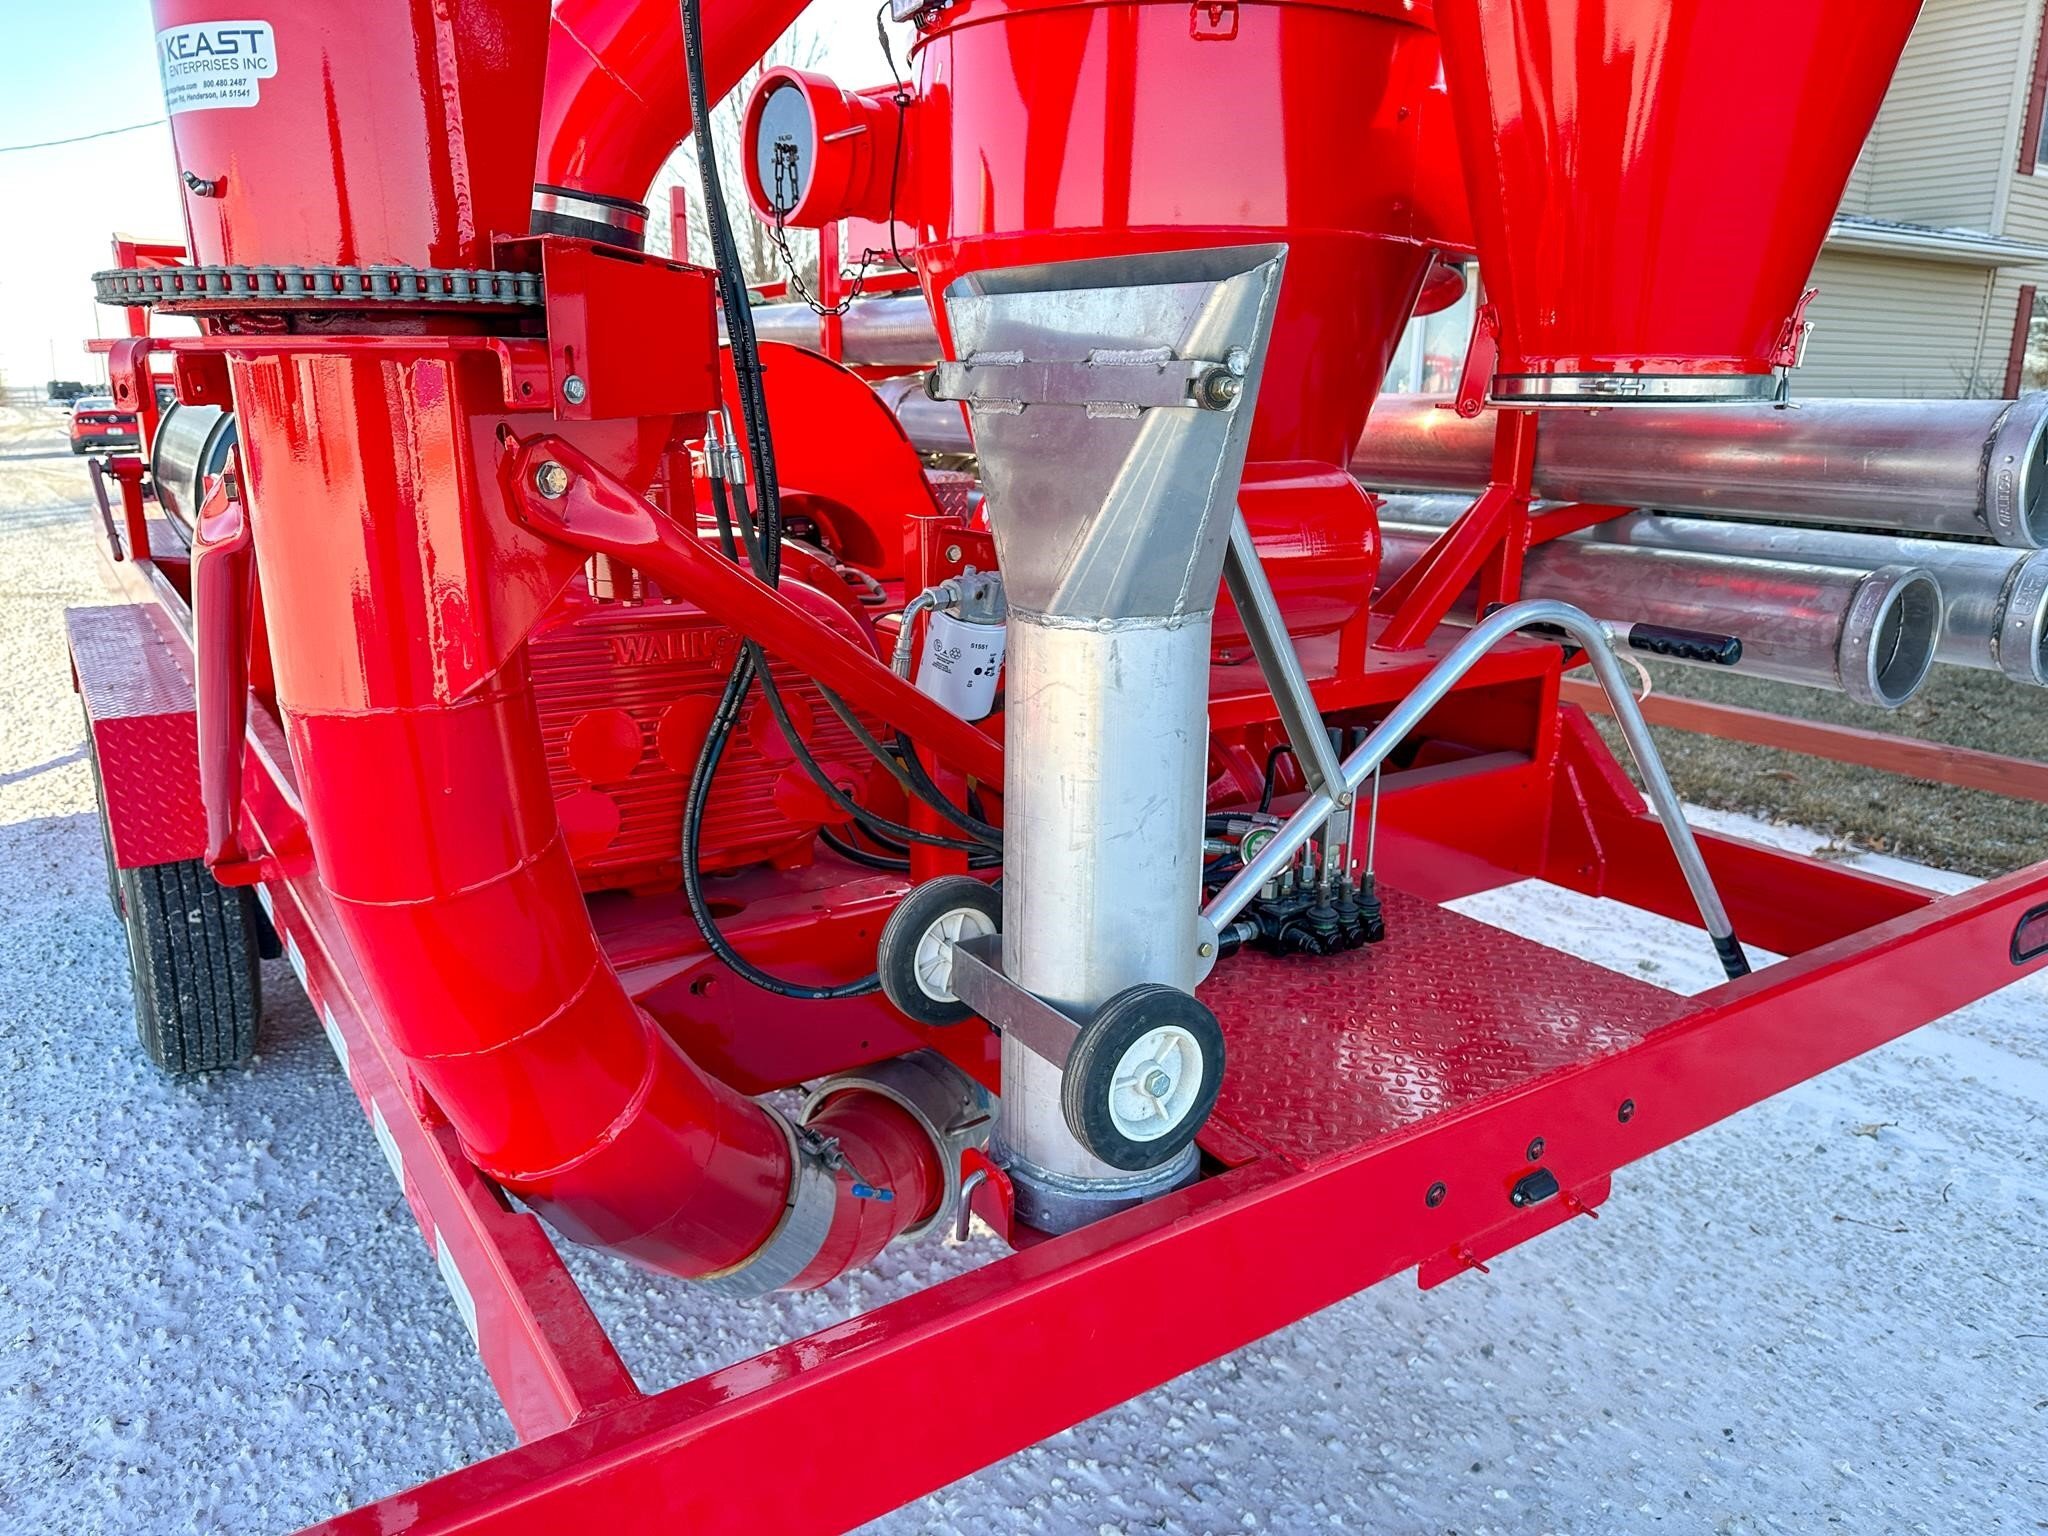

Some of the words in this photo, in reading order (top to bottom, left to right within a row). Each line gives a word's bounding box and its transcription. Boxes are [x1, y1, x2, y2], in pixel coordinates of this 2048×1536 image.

[165, 29, 264, 62] KEAST
[169, 58, 239, 77] ENTERPRISES
[243, 57, 268, 70] INC
[203, 78, 247, 89] 800.480.2487
[187, 91, 218, 102] Henderson,
[229, 89, 250, 97] 51541
